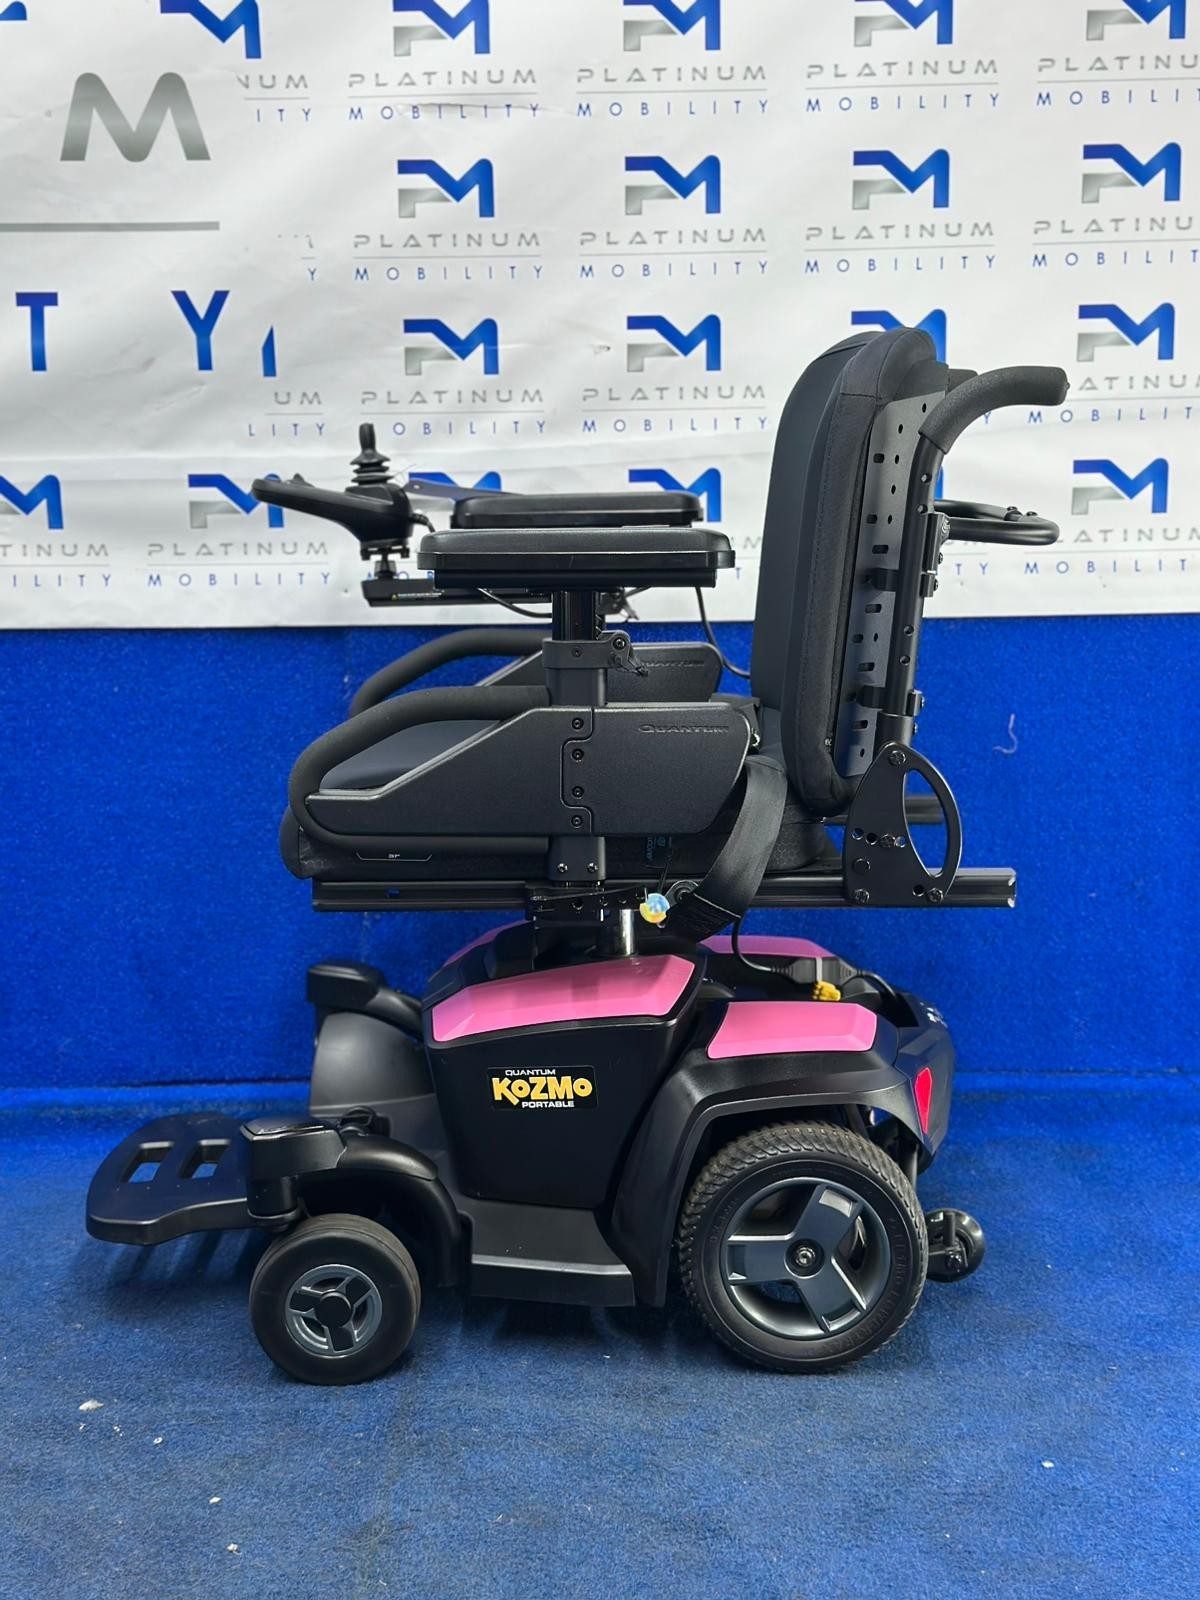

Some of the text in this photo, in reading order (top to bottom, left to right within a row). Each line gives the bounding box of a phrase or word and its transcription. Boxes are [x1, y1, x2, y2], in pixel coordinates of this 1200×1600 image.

[806, 59, 998, 79] PLATINUM
[1038, 54, 1199, 72] PLATINU
[349, 68, 537, 87] PLATINUM
[577, 65, 766, 83] PLATINUM
[577, 100, 768, 117] MOBILITY
[806, 92, 999, 112] MOBILITY
[349, 103, 540, 121] MOBILITY
[805, 221, 994, 241] PLATINUM
[1033, 216, 1193, 235] PLATINU
[354, 232, 540, 248] PLATINUM
[580, 227, 766, 246] PLATINUM
[805, 255, 996, 274] MOBILITY
[1032, 249, 1199, 268] MOBILIT
[355, 266, 543, 281] MOBILITY
[580, 261, 768, 278] MOBILITY
[1078, 374, 1200, 391] ATINU
[361, 389, 543, 405] PLATINUM
[582, 384, 765, 402] PLATINUM
[1028, 406, 1193, 424] MOBILIT
[392, 420, 546, 436] OBILITY
[582, 416, 767, 433] MOBILITY
[148, 542, 328, 556] PLATINUM
[1024, 558, 1187, 575] MOBILIT
[148, 572, 330, 587] MOBILITY
[521, 1101, 575, 1109] PORTABLE
